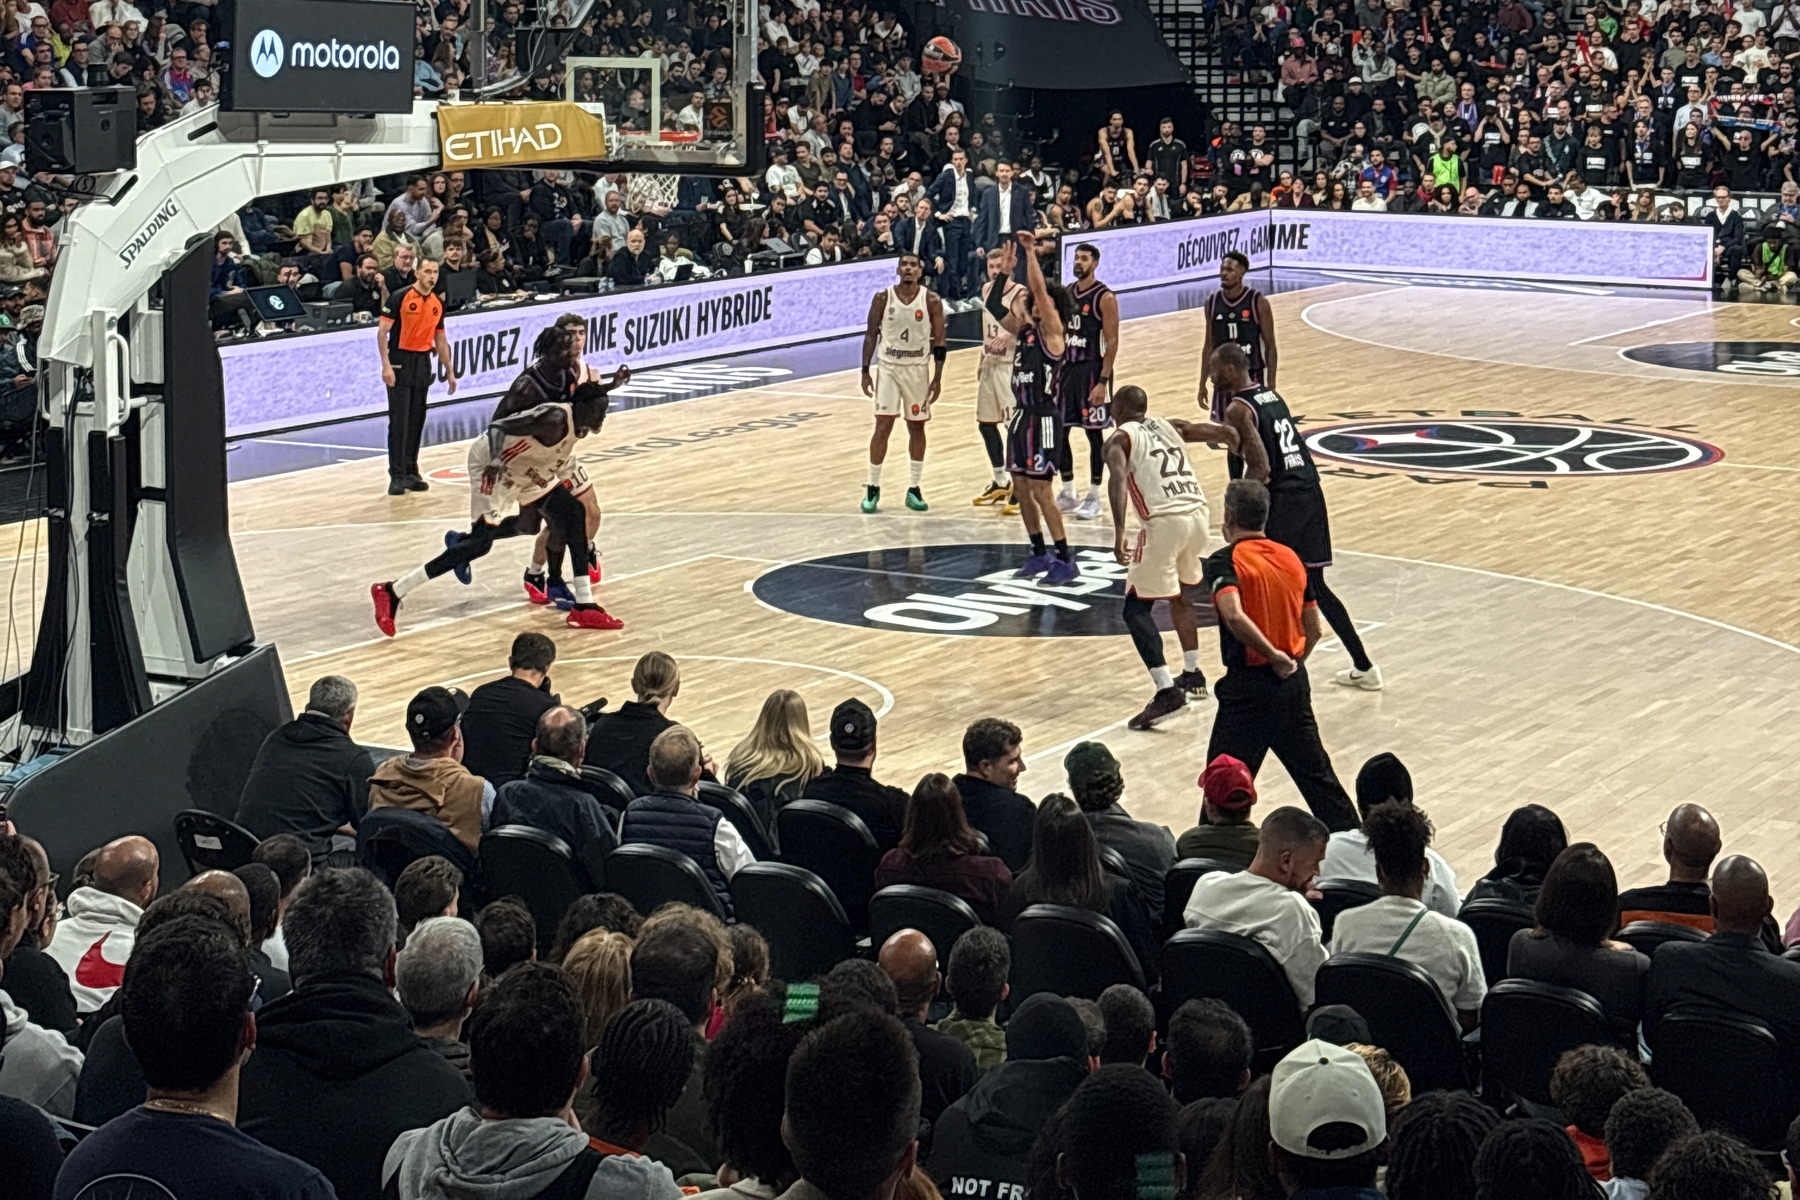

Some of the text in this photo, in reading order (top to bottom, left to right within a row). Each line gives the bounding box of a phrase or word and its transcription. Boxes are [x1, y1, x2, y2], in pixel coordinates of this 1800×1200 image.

[291, 38, 400, 70] motorola
[445, 123, 562, 160] ETIHAD
[119, 198, 177, 270] SPALDING
[1177, 227, 1240, 270] DÉCOUVREZ
[1251, 223, 1311, 256] GAMME
[624, 305, 691, 355] SUZUKI
[697, 285, 773, 337] HYBRIDE
[1227, 322, 1239, 339] 11
[900, 328, 909, 343] 4
[1065, 333, 1087, 348] lyBet
[885, 346, 925, 360] siegmund
[1014, 352, 1022, 367] 2
[1089, 407, 1106, 422] 20
[1274, 418, 1300, 454] 22
[1034, 454, 1043, 471] 2
[1149, 446, 1193, 478] 22
[572, 466, 588, 488] 10
[951, 1176, 992, 1197] NOT
